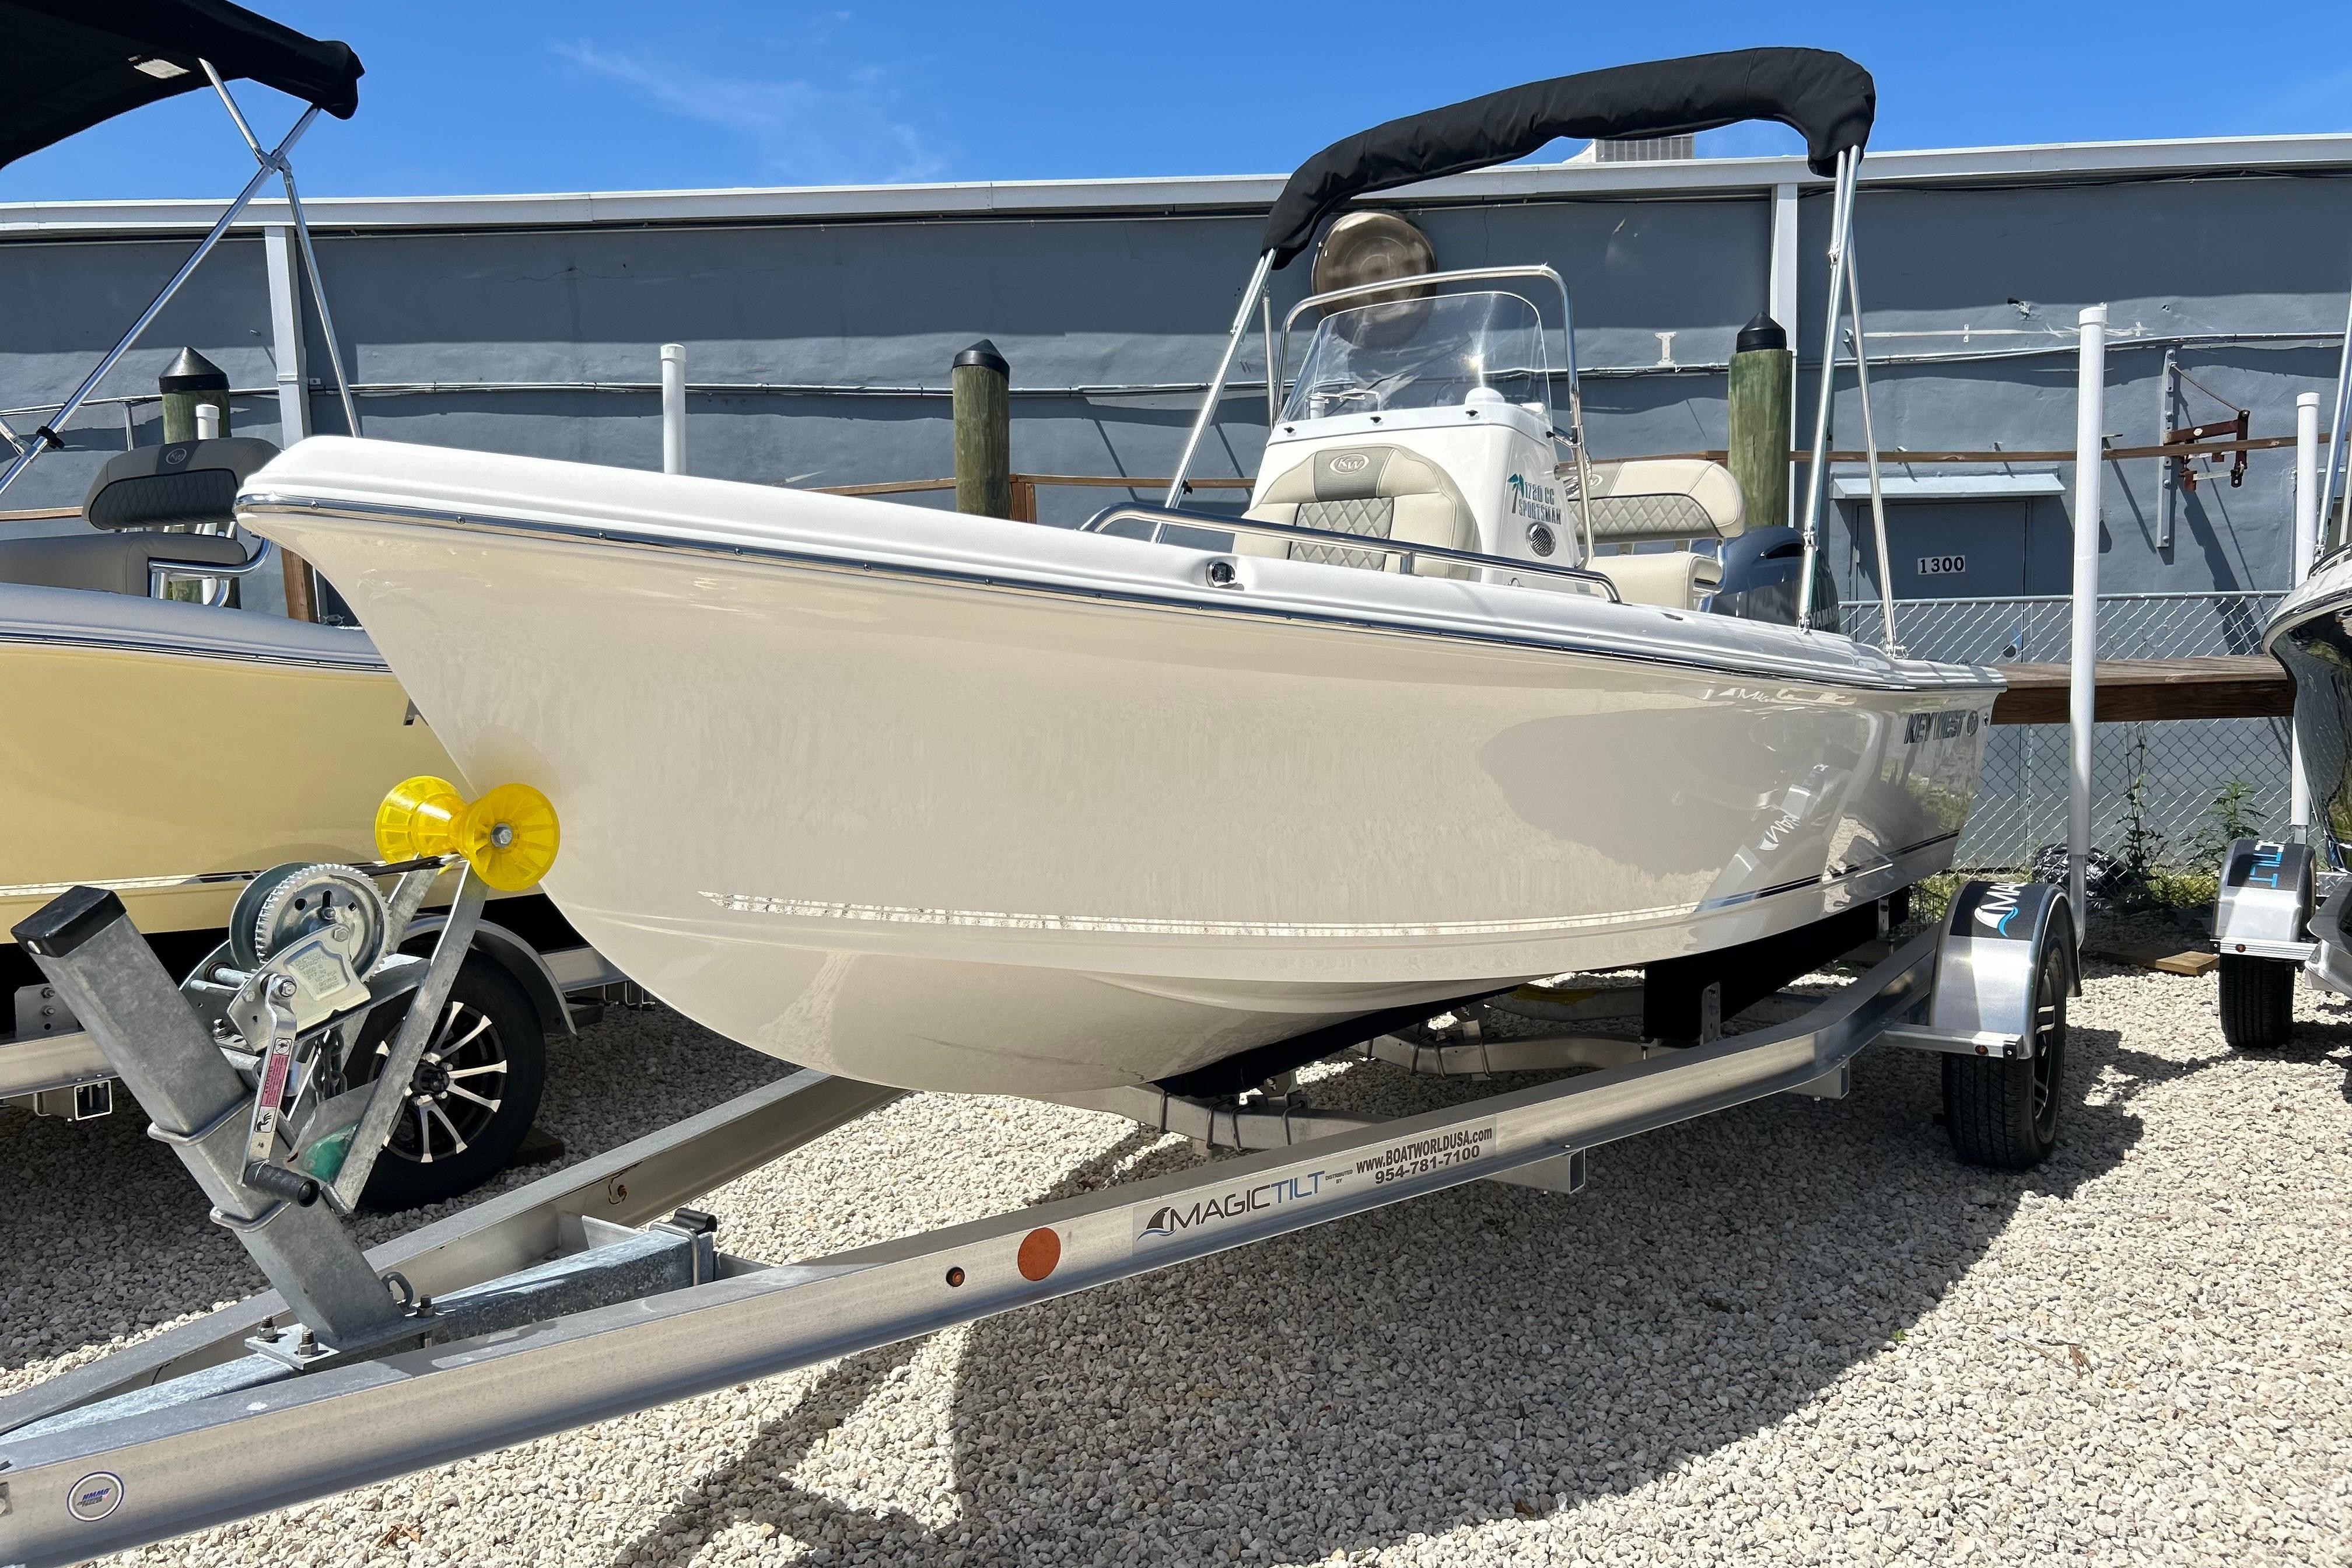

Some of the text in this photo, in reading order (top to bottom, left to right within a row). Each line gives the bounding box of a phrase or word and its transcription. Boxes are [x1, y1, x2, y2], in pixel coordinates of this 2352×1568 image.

[1337, 458, 1364, 471] KW
[1525, 482, 1555, 505] 1720 CC
[1519, 499, 1562, 525] SPORTSMAN
[1920, 556, 1964, 573] 1300
[1904, 713, 1935, 744] KEY
[1933, 709, 1966, 740] WEST
[1356, 1128, 1492, 1174] www.BOATWORLDUSA.com
[1325, 1169, 1353, 1181] DISTRIBUTED
[1376, 1145, 1480, 1184] 954-781-7100
[1170, 1171, 1325, 1231] MAGICTILT
